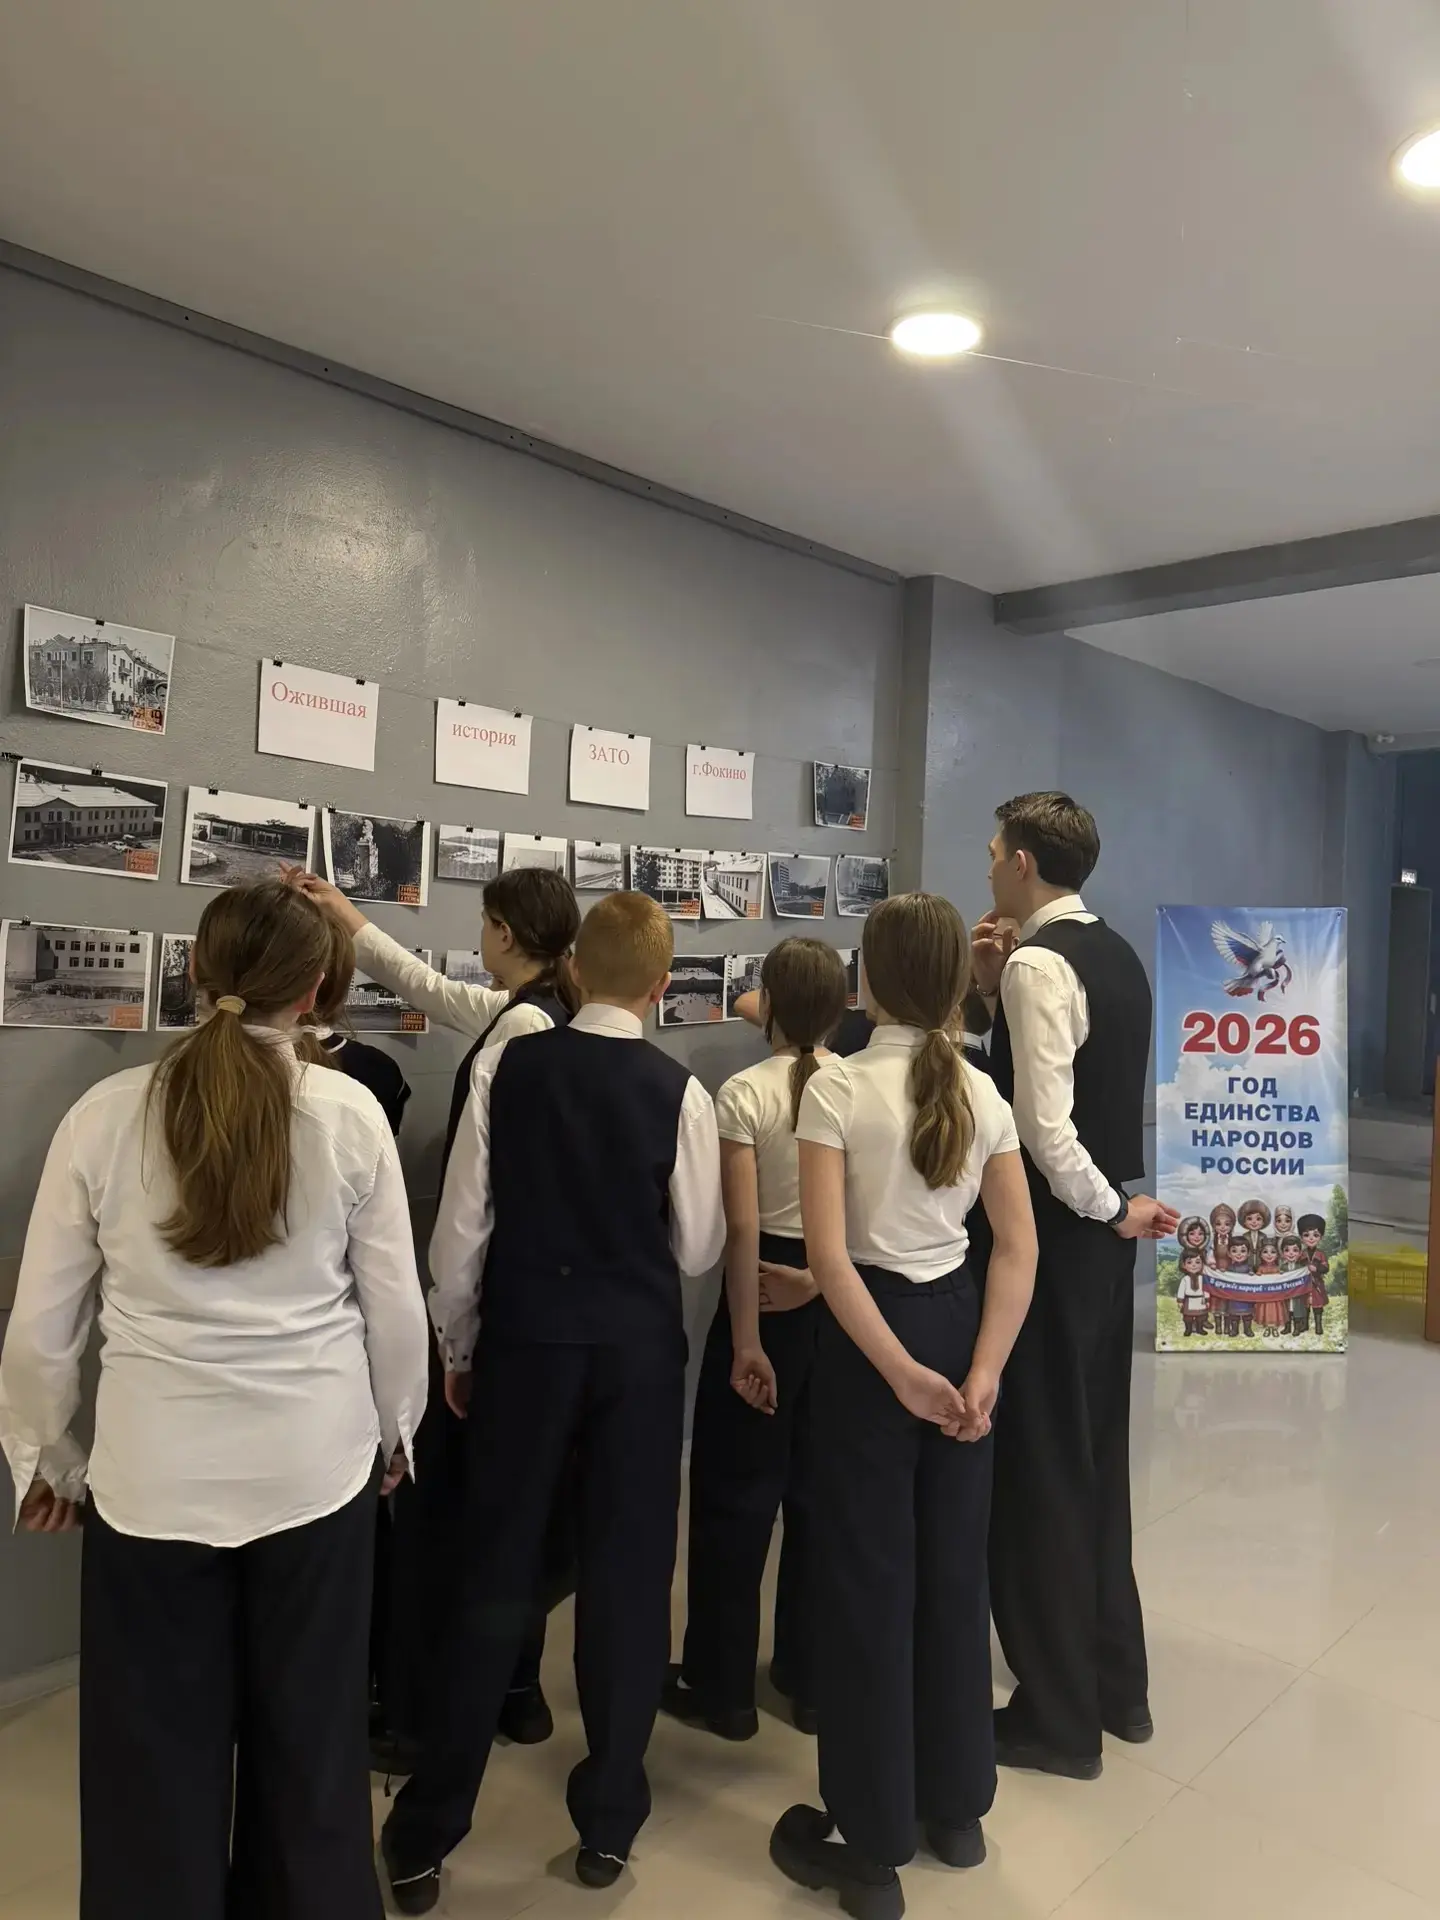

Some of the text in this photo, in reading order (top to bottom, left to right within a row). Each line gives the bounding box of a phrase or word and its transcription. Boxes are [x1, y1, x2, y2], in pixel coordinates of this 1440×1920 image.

[271, 681, 747, 781] Ожившая история ЗАТО г.Фокино
[1183, 1012, 1320, 1056] 2026
[1228, 1076, 1278, 1098] ГОД
[1184, 1102, 1321, 1124] ЕДИНСТВА
[1191, 1129, 1314, 1151] НАРОДОВ
[1200, 1156, 1305, 1176] РОССИИ
